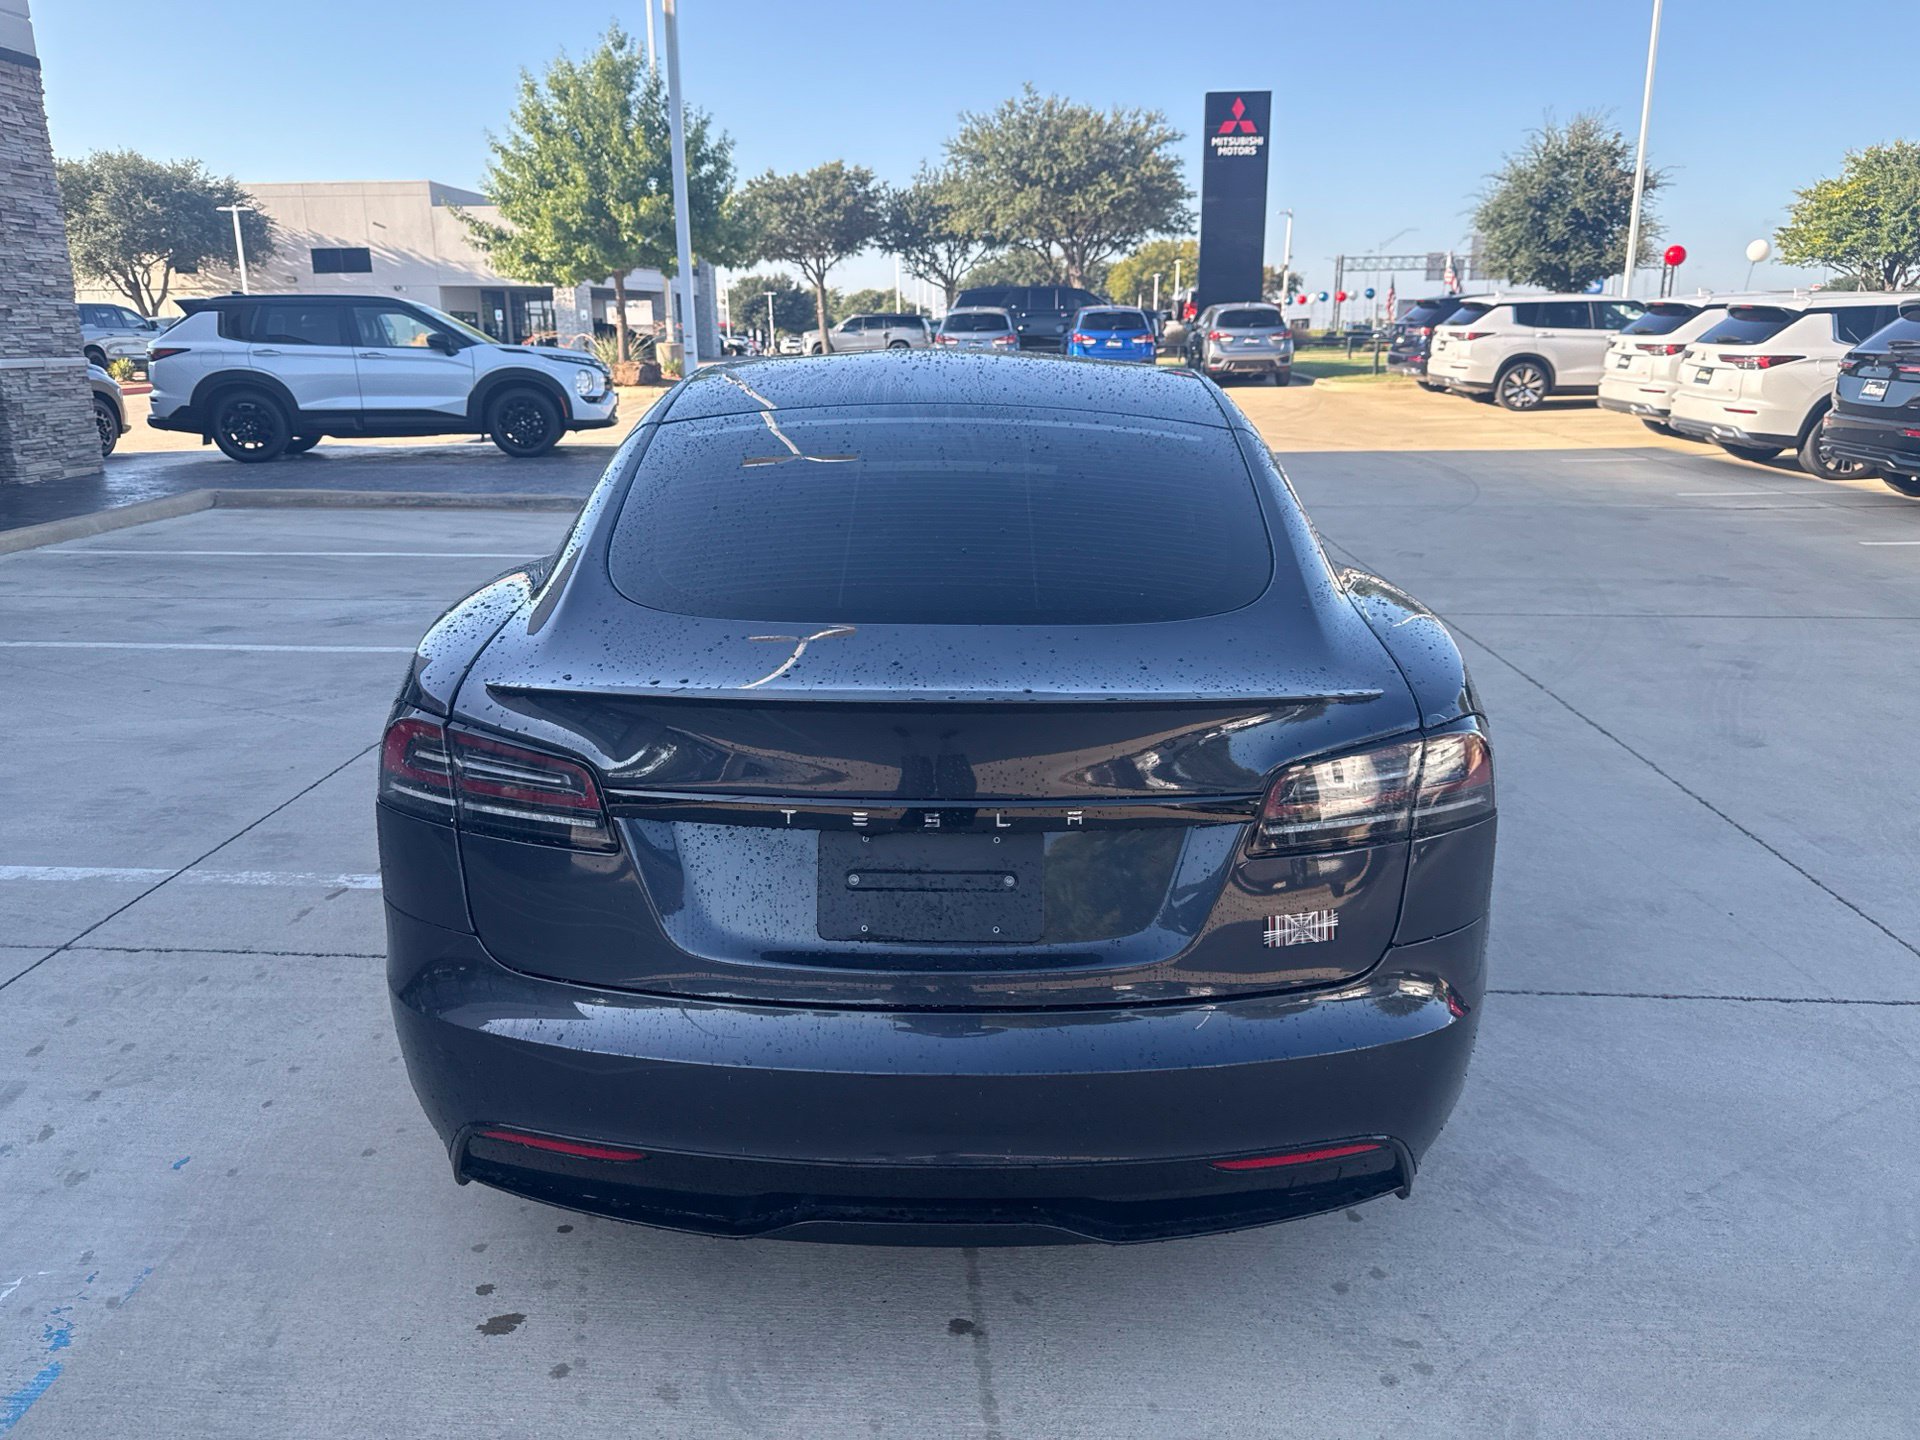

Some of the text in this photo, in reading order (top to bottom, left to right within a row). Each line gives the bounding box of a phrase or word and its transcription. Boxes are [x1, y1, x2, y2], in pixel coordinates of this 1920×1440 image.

[1211, 136, 1264, 146] MITSUBISHI
[1217, 146, 1257, 156] MOTORS
[780, 809, 1083, 828] TESLA
